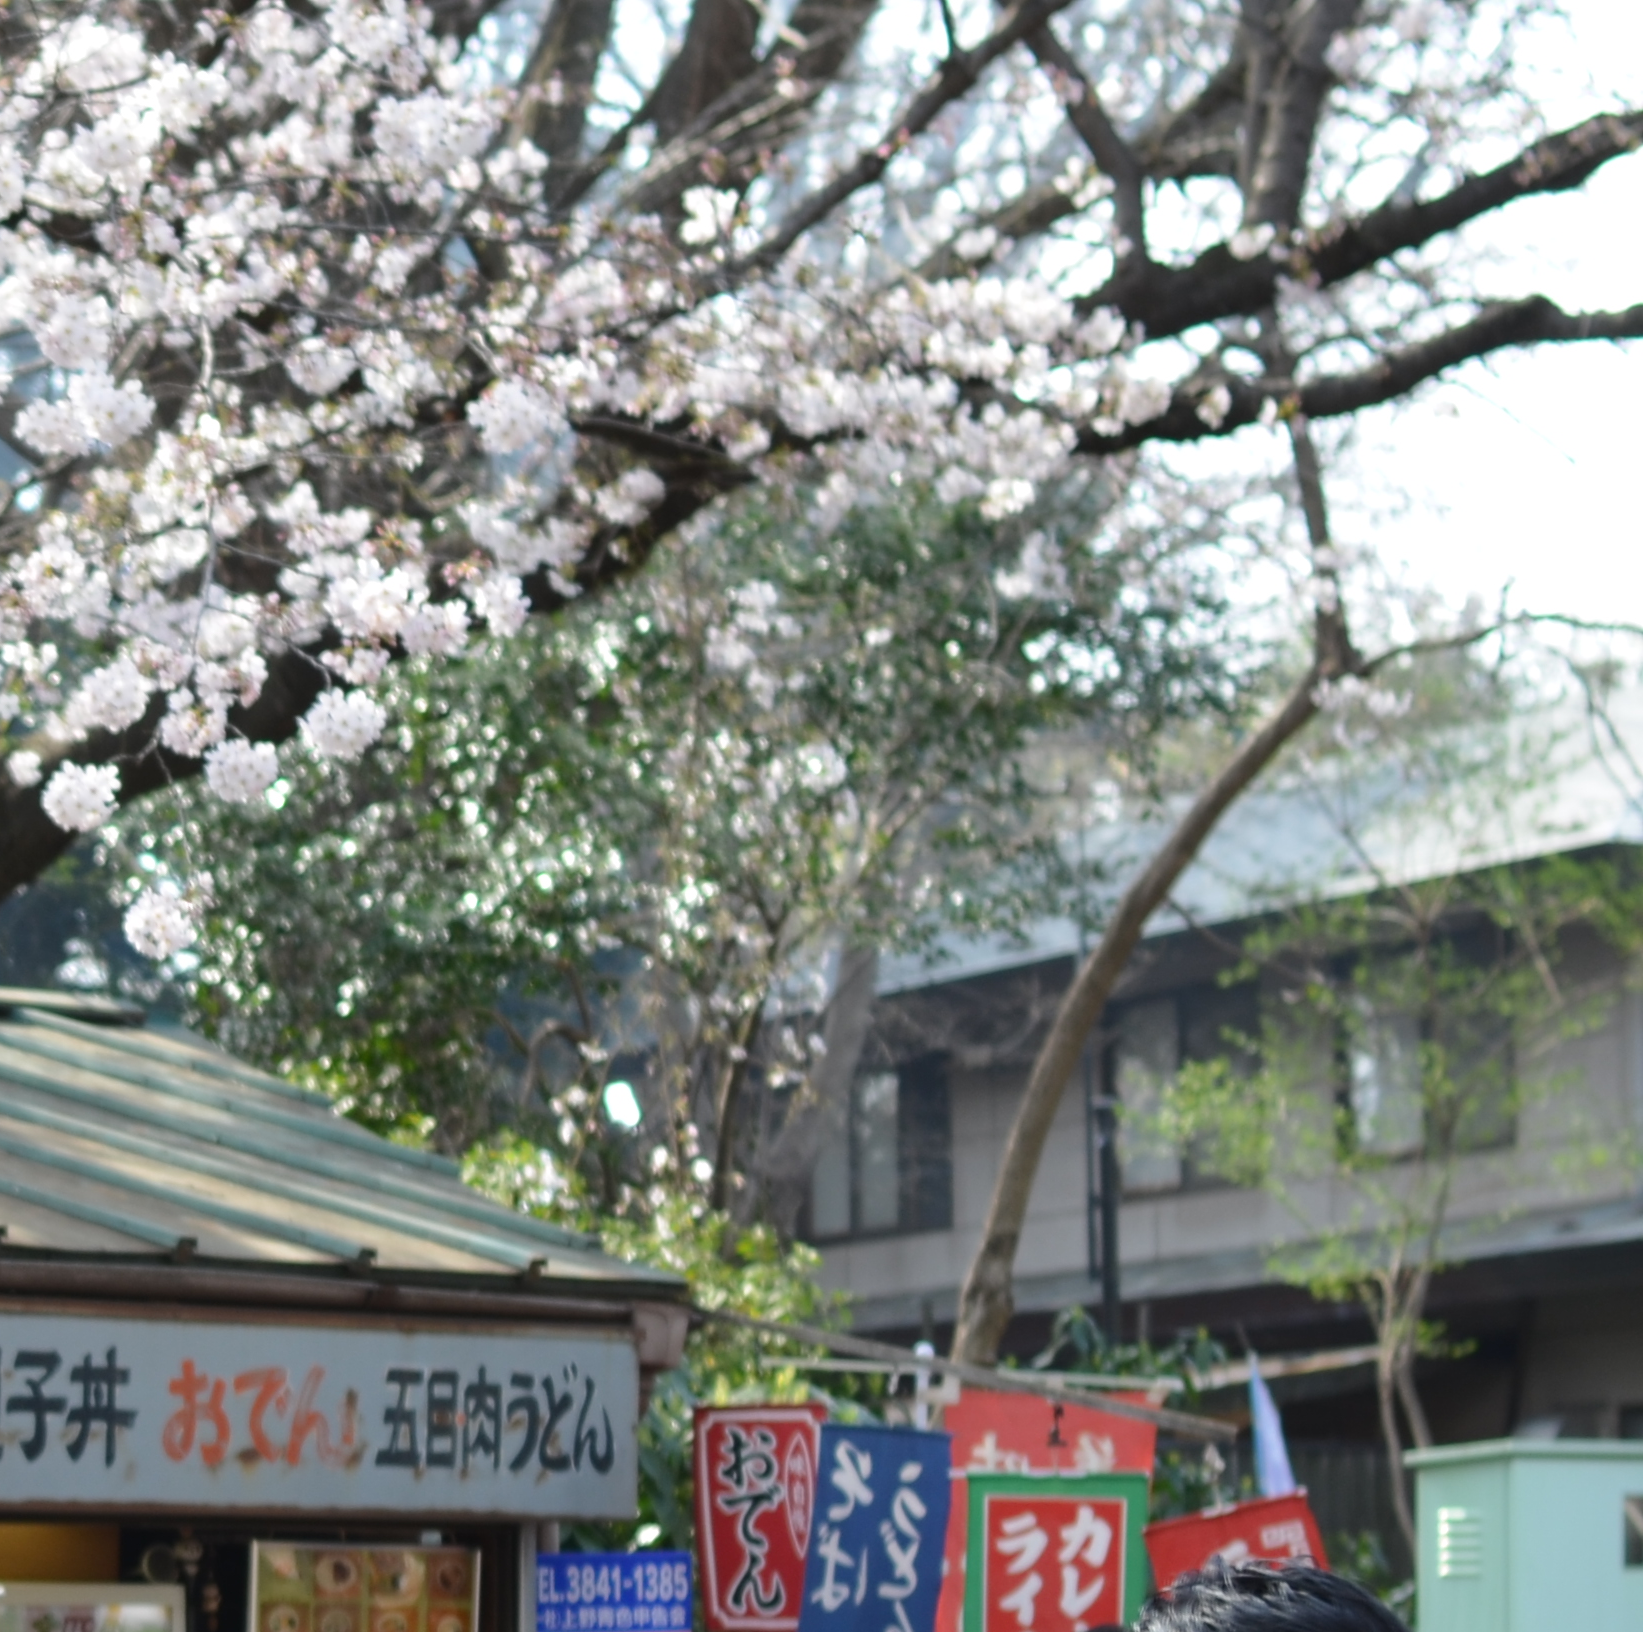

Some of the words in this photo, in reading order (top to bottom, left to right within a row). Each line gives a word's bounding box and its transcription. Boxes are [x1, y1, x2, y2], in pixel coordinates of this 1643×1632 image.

[161, 1357, 363, 1470] おでん
[375, 1361, 615, 1475] 五目肉うどん
[718, 1424, 786, 1615] おでん
[537, 1562, 690, 1604] EL.3841-1385
